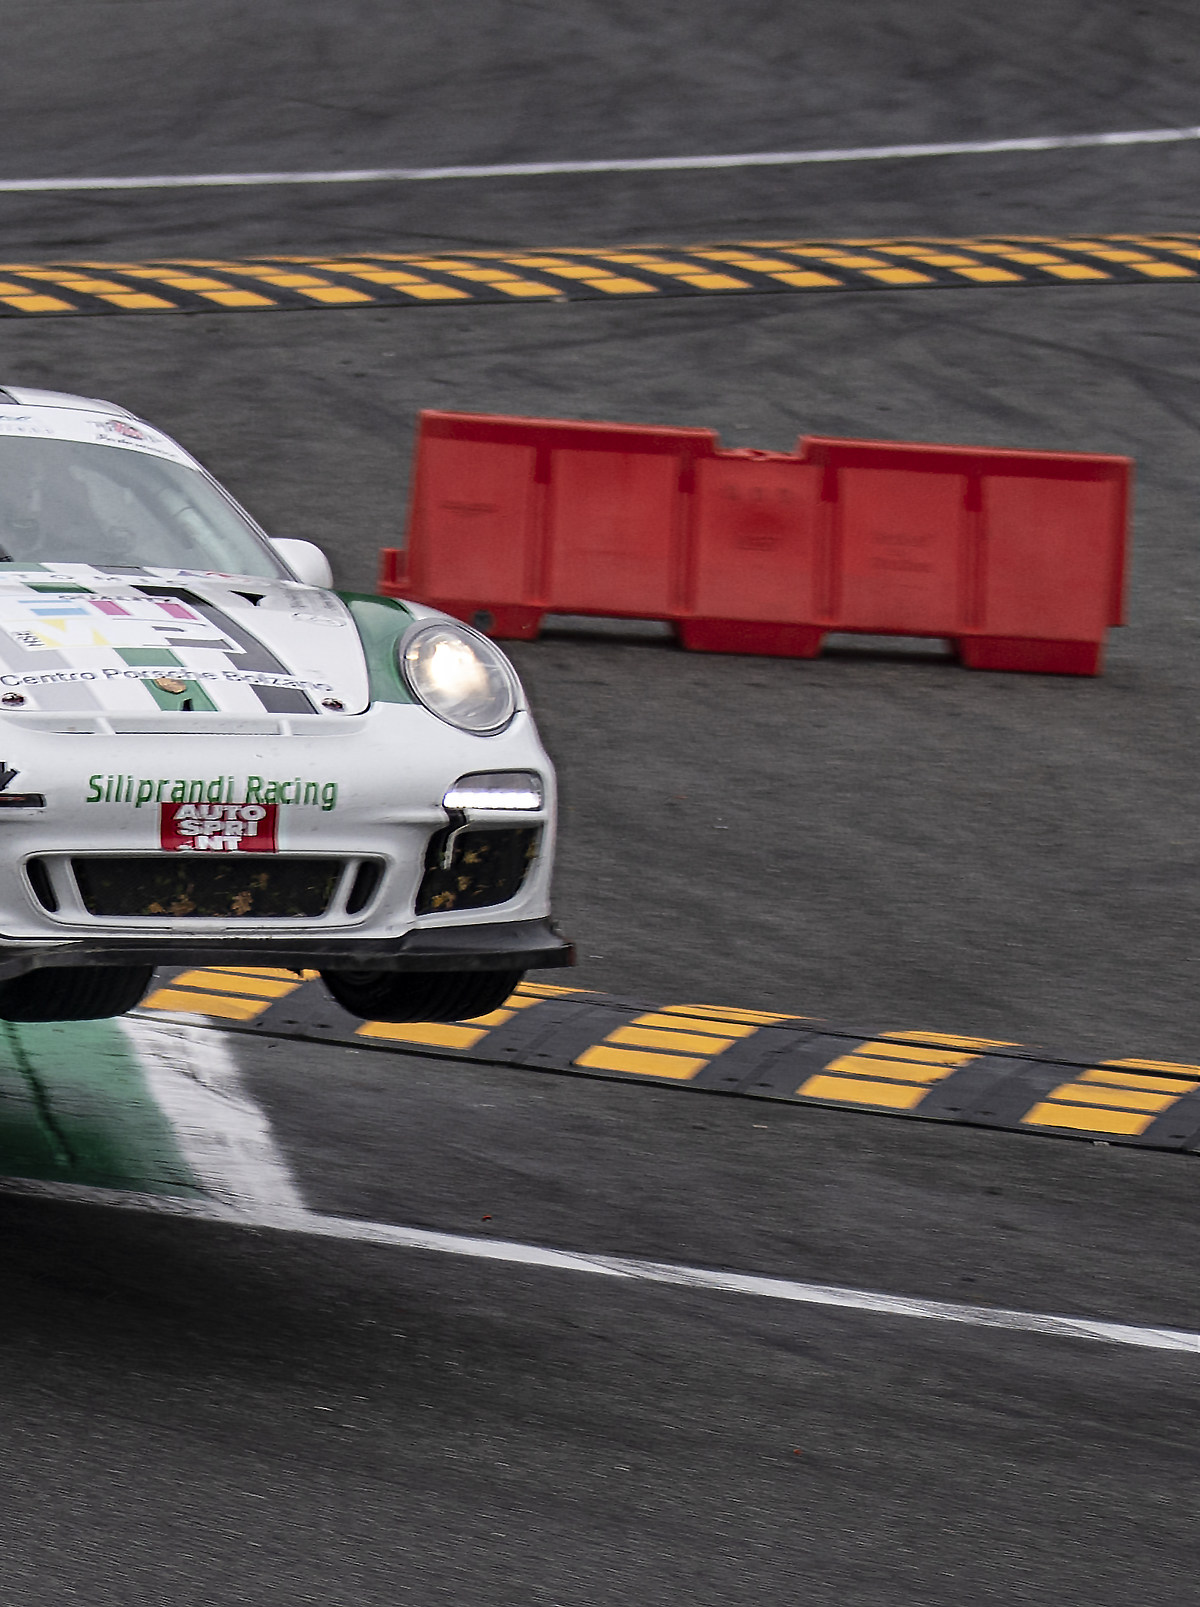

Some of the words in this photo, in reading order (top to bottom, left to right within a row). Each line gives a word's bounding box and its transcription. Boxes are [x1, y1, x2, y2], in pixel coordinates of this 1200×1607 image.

[0, 671, 97, 687] Centro
[101, 668, 218, 682] Porsche
[223, 670, 335, 693] Bolzano
[86, 773, 236, 808] Siliprandi
[245, 775, 339, 812] Racing
[173, 804, 267, 821] AUTO
[176, 819, 258, 837] SPRI
